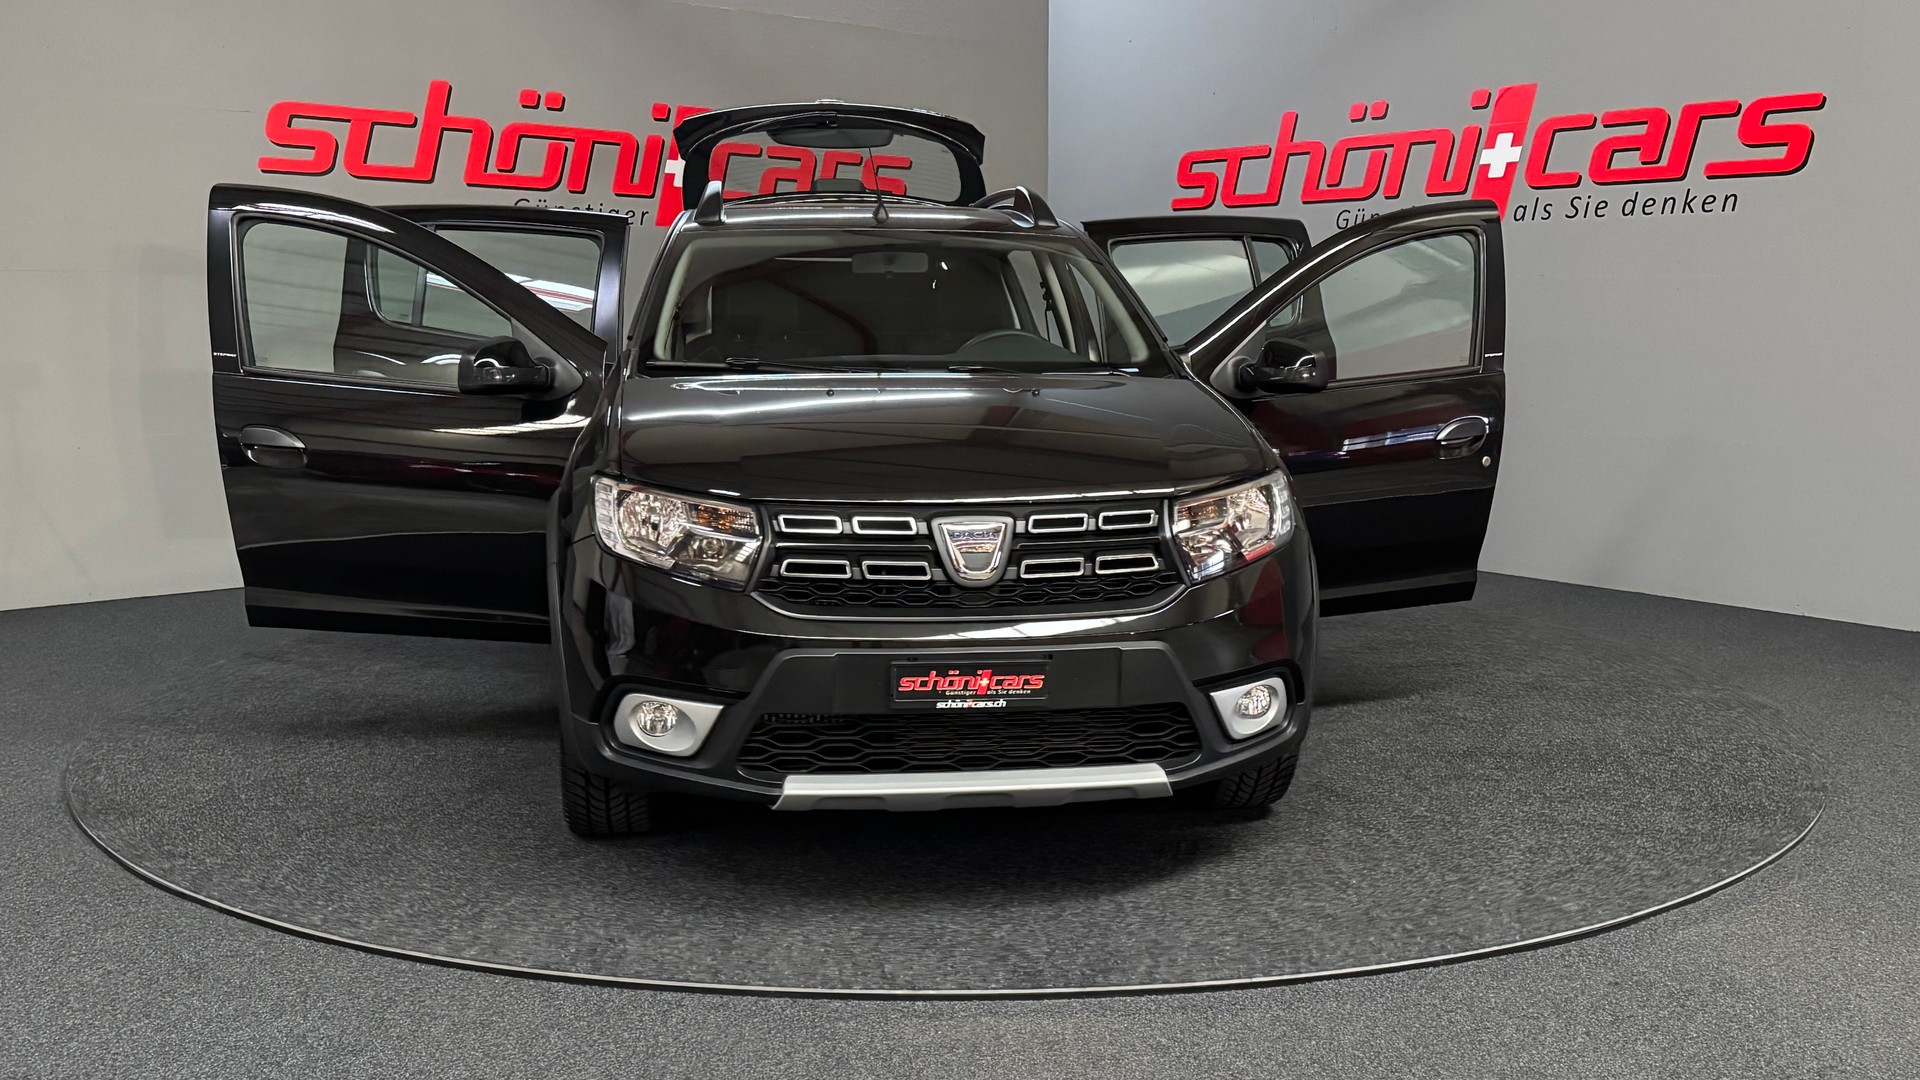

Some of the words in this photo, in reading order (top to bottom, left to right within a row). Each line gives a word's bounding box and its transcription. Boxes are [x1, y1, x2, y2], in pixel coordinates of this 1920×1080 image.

[1513, 197, 1553, 222] als
[1565, 195, 1609, 219] Sie
[1621, 188, 1738, 217] denken
